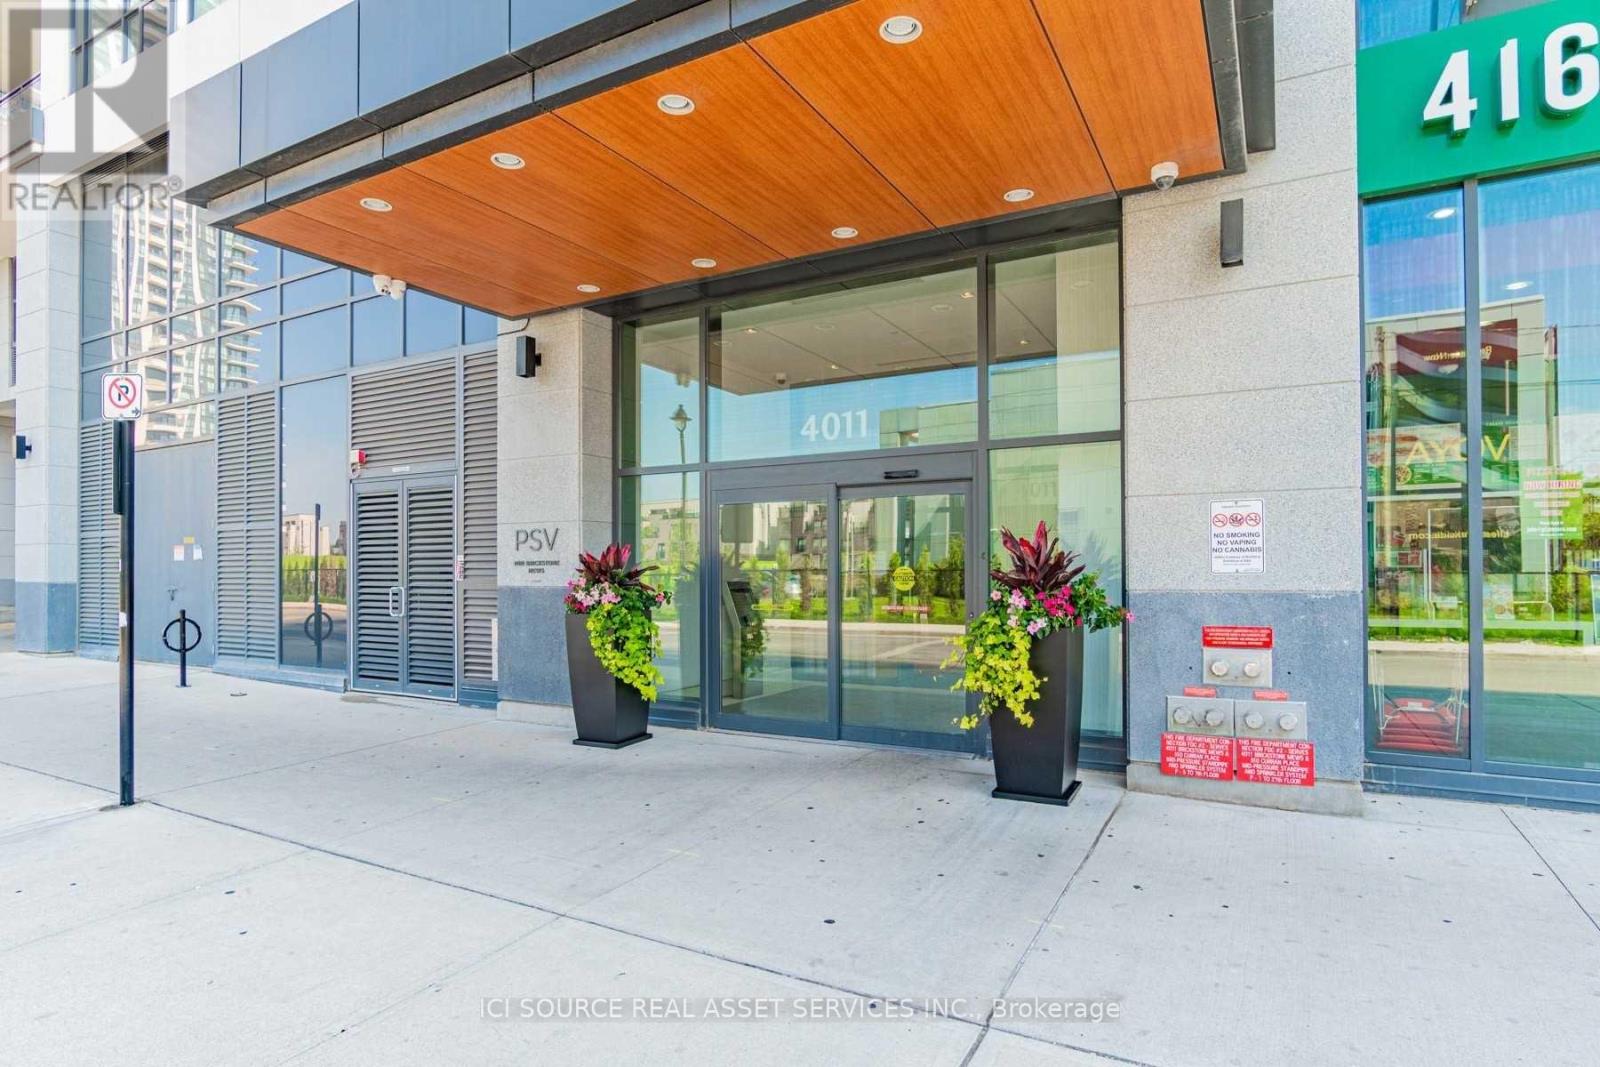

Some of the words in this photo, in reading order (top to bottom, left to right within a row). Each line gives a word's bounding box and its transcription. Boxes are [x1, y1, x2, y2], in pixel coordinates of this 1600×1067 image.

[1423, 22, 1600, 132] 416
[800, 409, 867, 442] 4011
[515, 528, 559, 552] PSV
[1226, 531, 1260, 539] SMOKING
